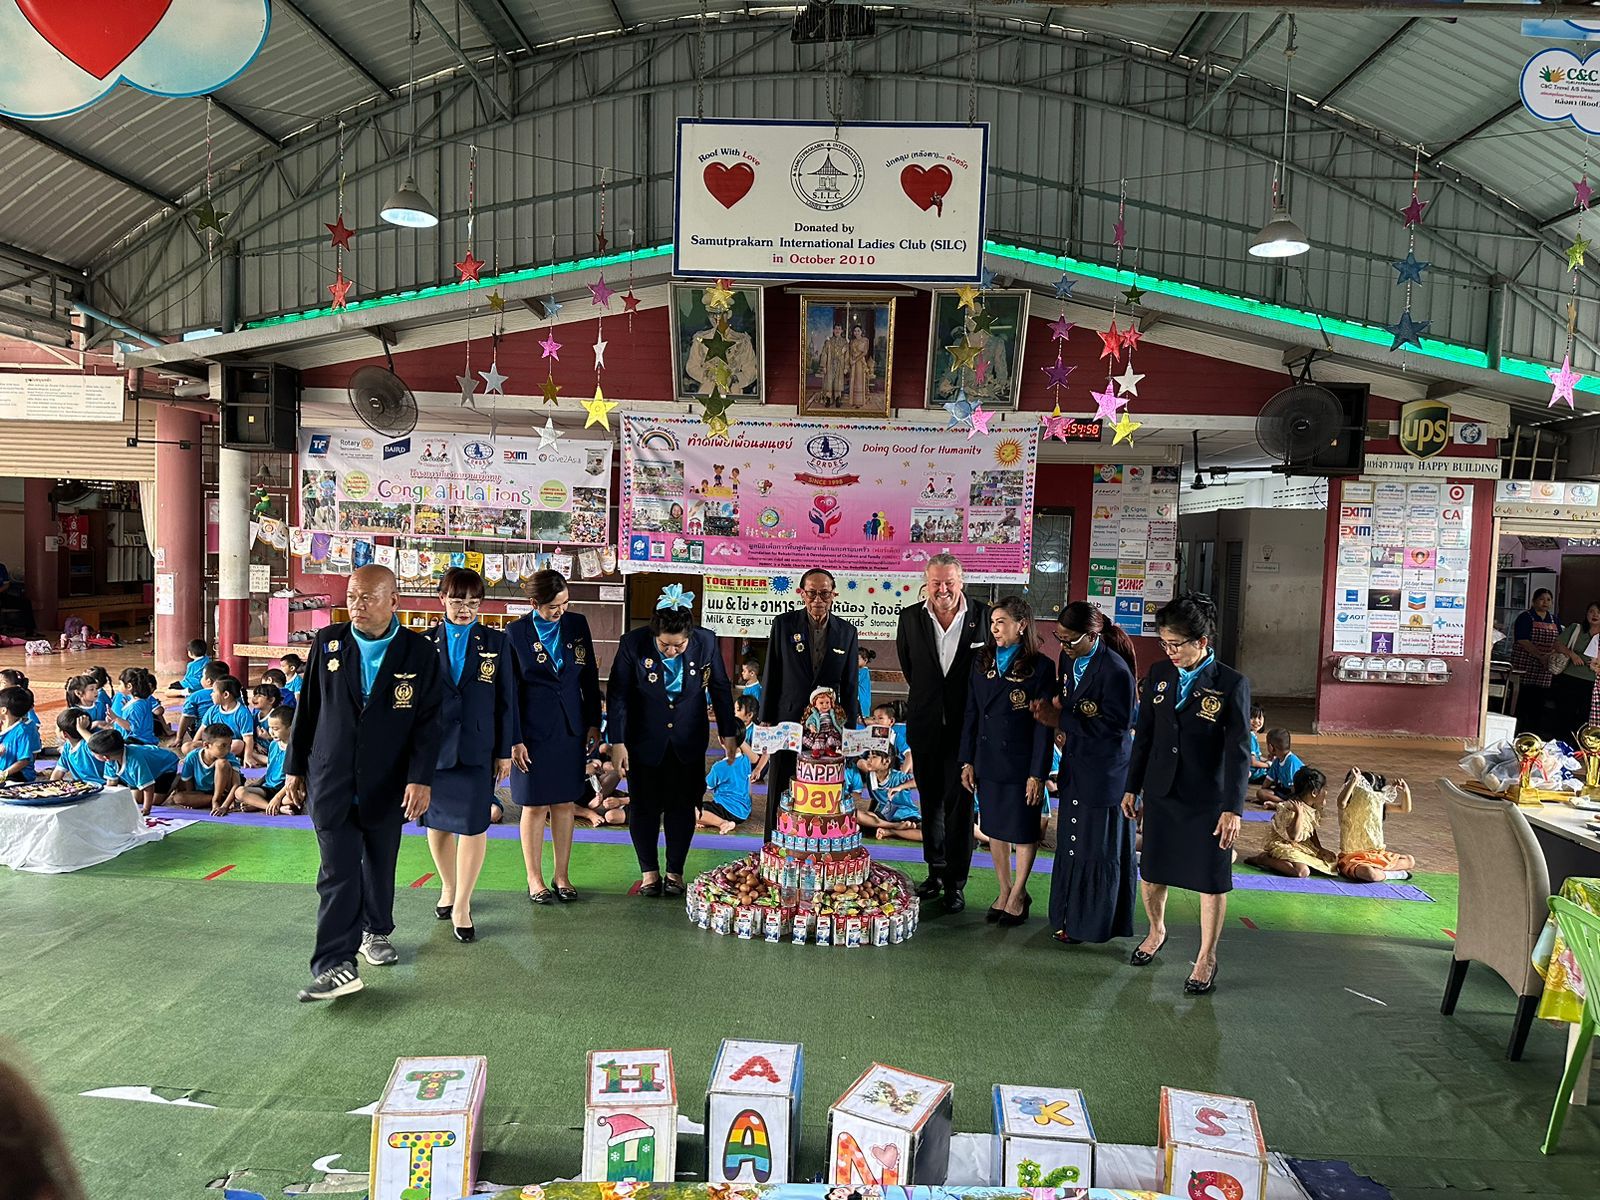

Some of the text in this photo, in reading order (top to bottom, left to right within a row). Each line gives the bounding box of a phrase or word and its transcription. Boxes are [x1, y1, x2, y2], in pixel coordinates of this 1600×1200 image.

[1567, 68, 1598, 82] C&C
[698, 148, 761, 166] Roof With Love
[794, 223, 855, 235] Donated by
[690, 235, 967, 252] Samutprakarn International Ladies Club (SILC)
[772, 253, 876, 265] in October 2010
[1403, 418, 1447, 451] ups
[313, 440, 326, 449] TF
[340, 439, 361, 448] Rotary
[384, 445, 406, 453] BAIRD
[862, 443, 982, 457] Doing Good for Humanity
[503, 450, 527, 460] EXIM
[811, 457, 844, 468] FORDEC
[1418, 462, 1450, 471] HAPPY
[1452, 462, 1498, 473] BUILDING
[808, 477, 826, 486] SINCE
[378, 480, 532, 505] Congratulations
[1342, 506, 1371, 518] EXIM
[1442, 509, 1462, 520] CA
[1341, 525, 1371, 537] EXIM
[705, 577, 767, 587] TOGETHER
[707, 599, 724, 610] นม
[726, 596, 736, 610] &
[737, 596, 750, 611] ไข่
[751, 601, 758, 609] +
[760, 600, 795, 612] อาหาร
[871, 600, 903, 615] ท้องอิ่
[706, 615, 724, 623] Milk
[727, 615, 733, 623] &
[736, 616, 755, 627] Eggs
[846, 618, 865, 627] Kids
[857, 630, 890, 638] decthai.org
[797, 762, 844, 781] HAPPY
[793, 783, 841, 814] Day
[729, 1055, 782, 1084] A
[599, 1060, 664, 1093] H
[405, 1070, 466, 1100] T
[1195, 1107, 1228, 1136] S
[722, 1108, 772, 1184] A
[387, 1130, 456, 1200] T
